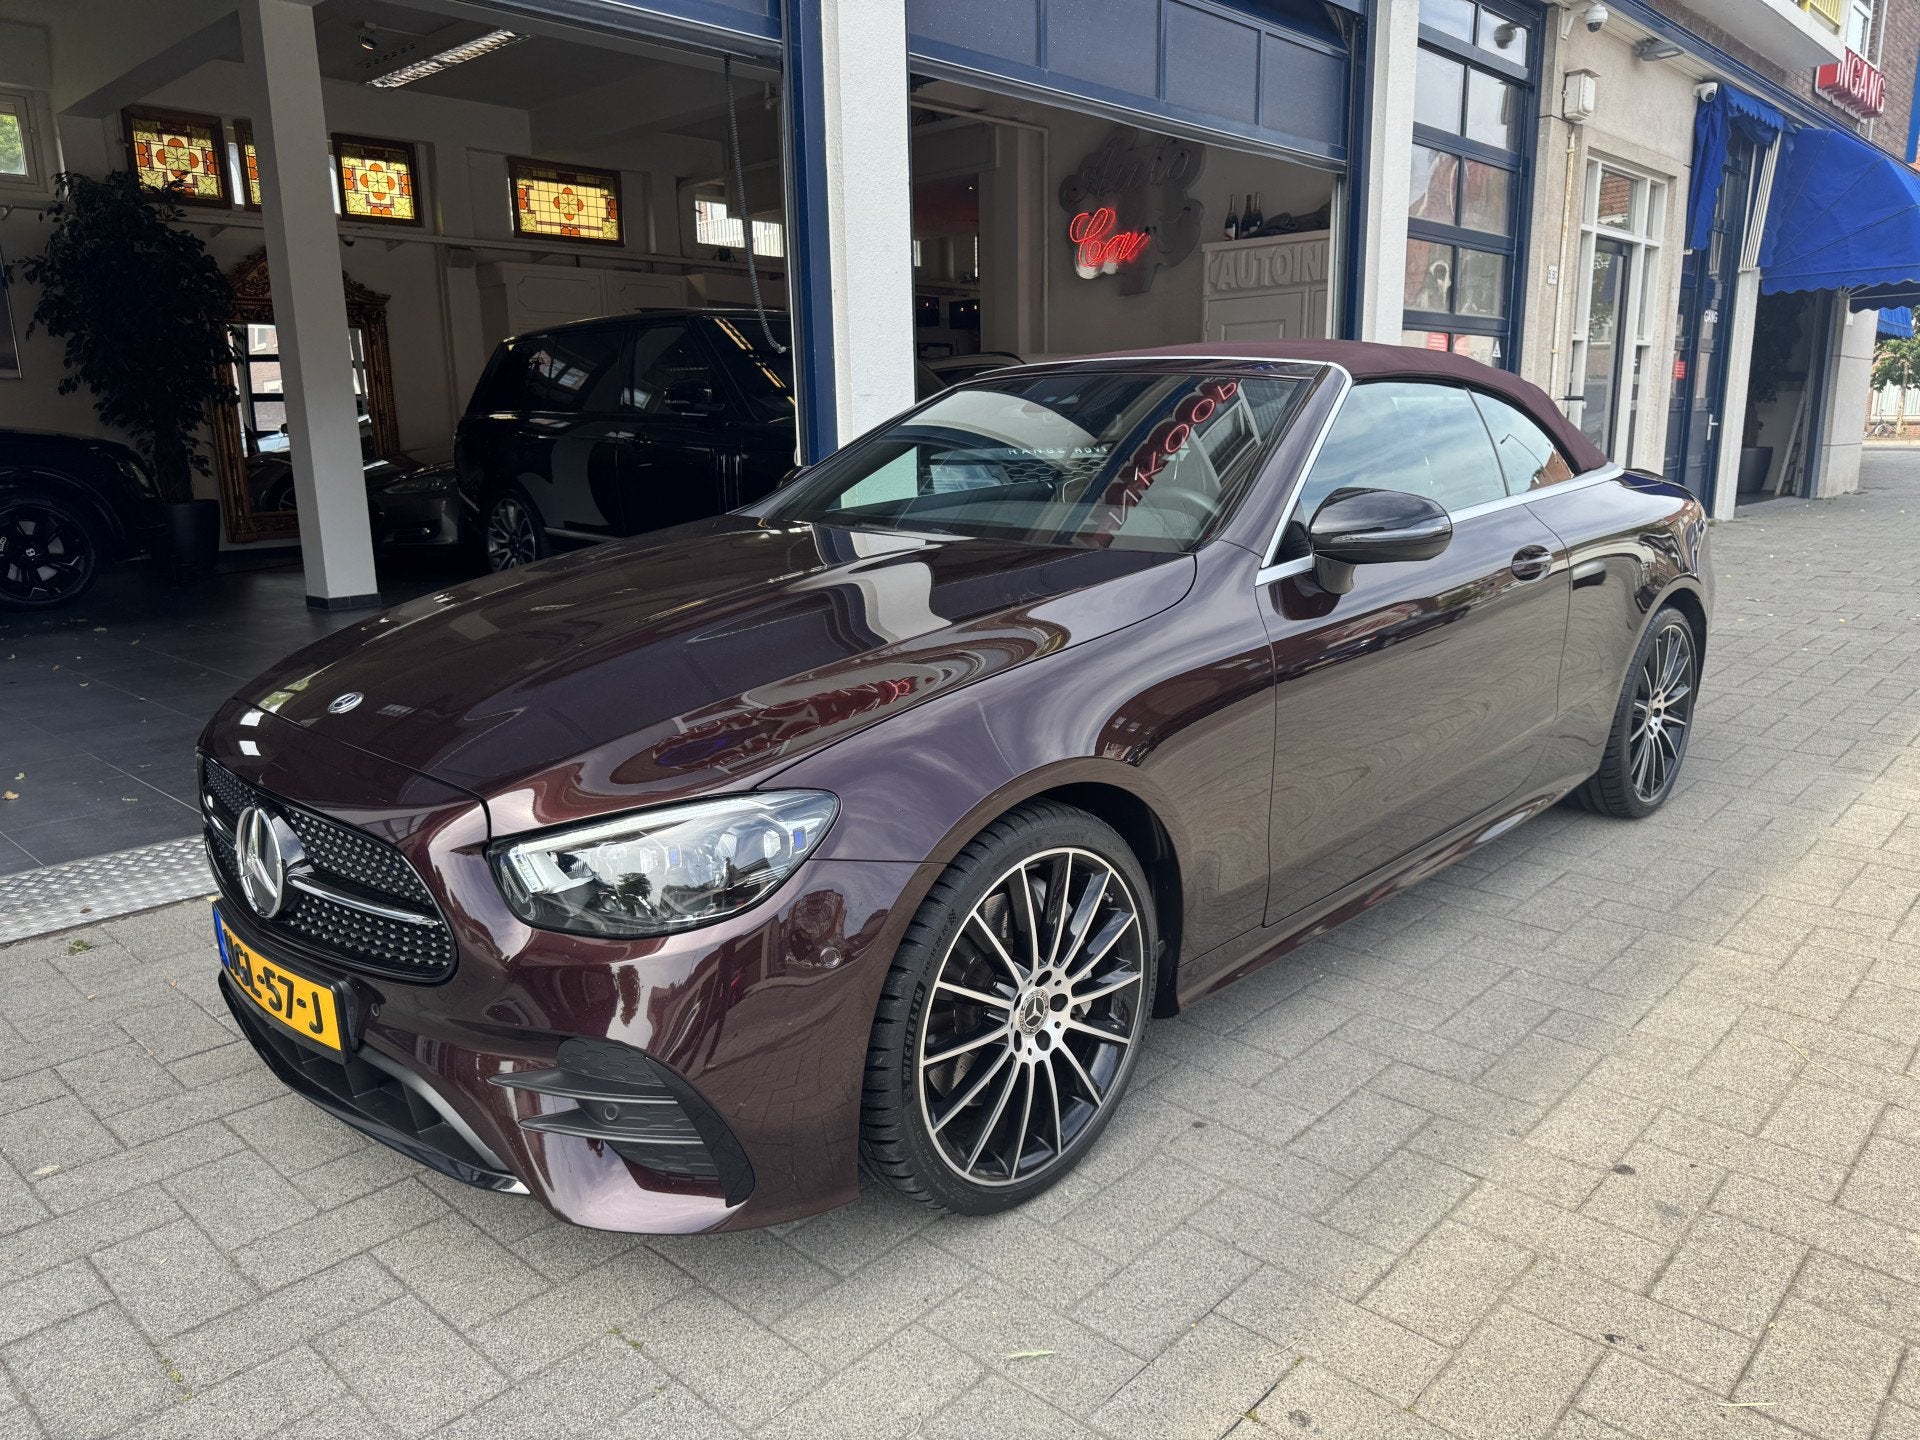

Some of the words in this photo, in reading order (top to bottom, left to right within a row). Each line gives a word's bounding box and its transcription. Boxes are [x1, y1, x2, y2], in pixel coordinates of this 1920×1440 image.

[1835, 51, 1886, 114] INGANG
[1216, 243, 1328, 291] AUTOIN
[1008, 447, 1065, 455] RANGE
[903, 986, 925, 1081] MICHELIN
